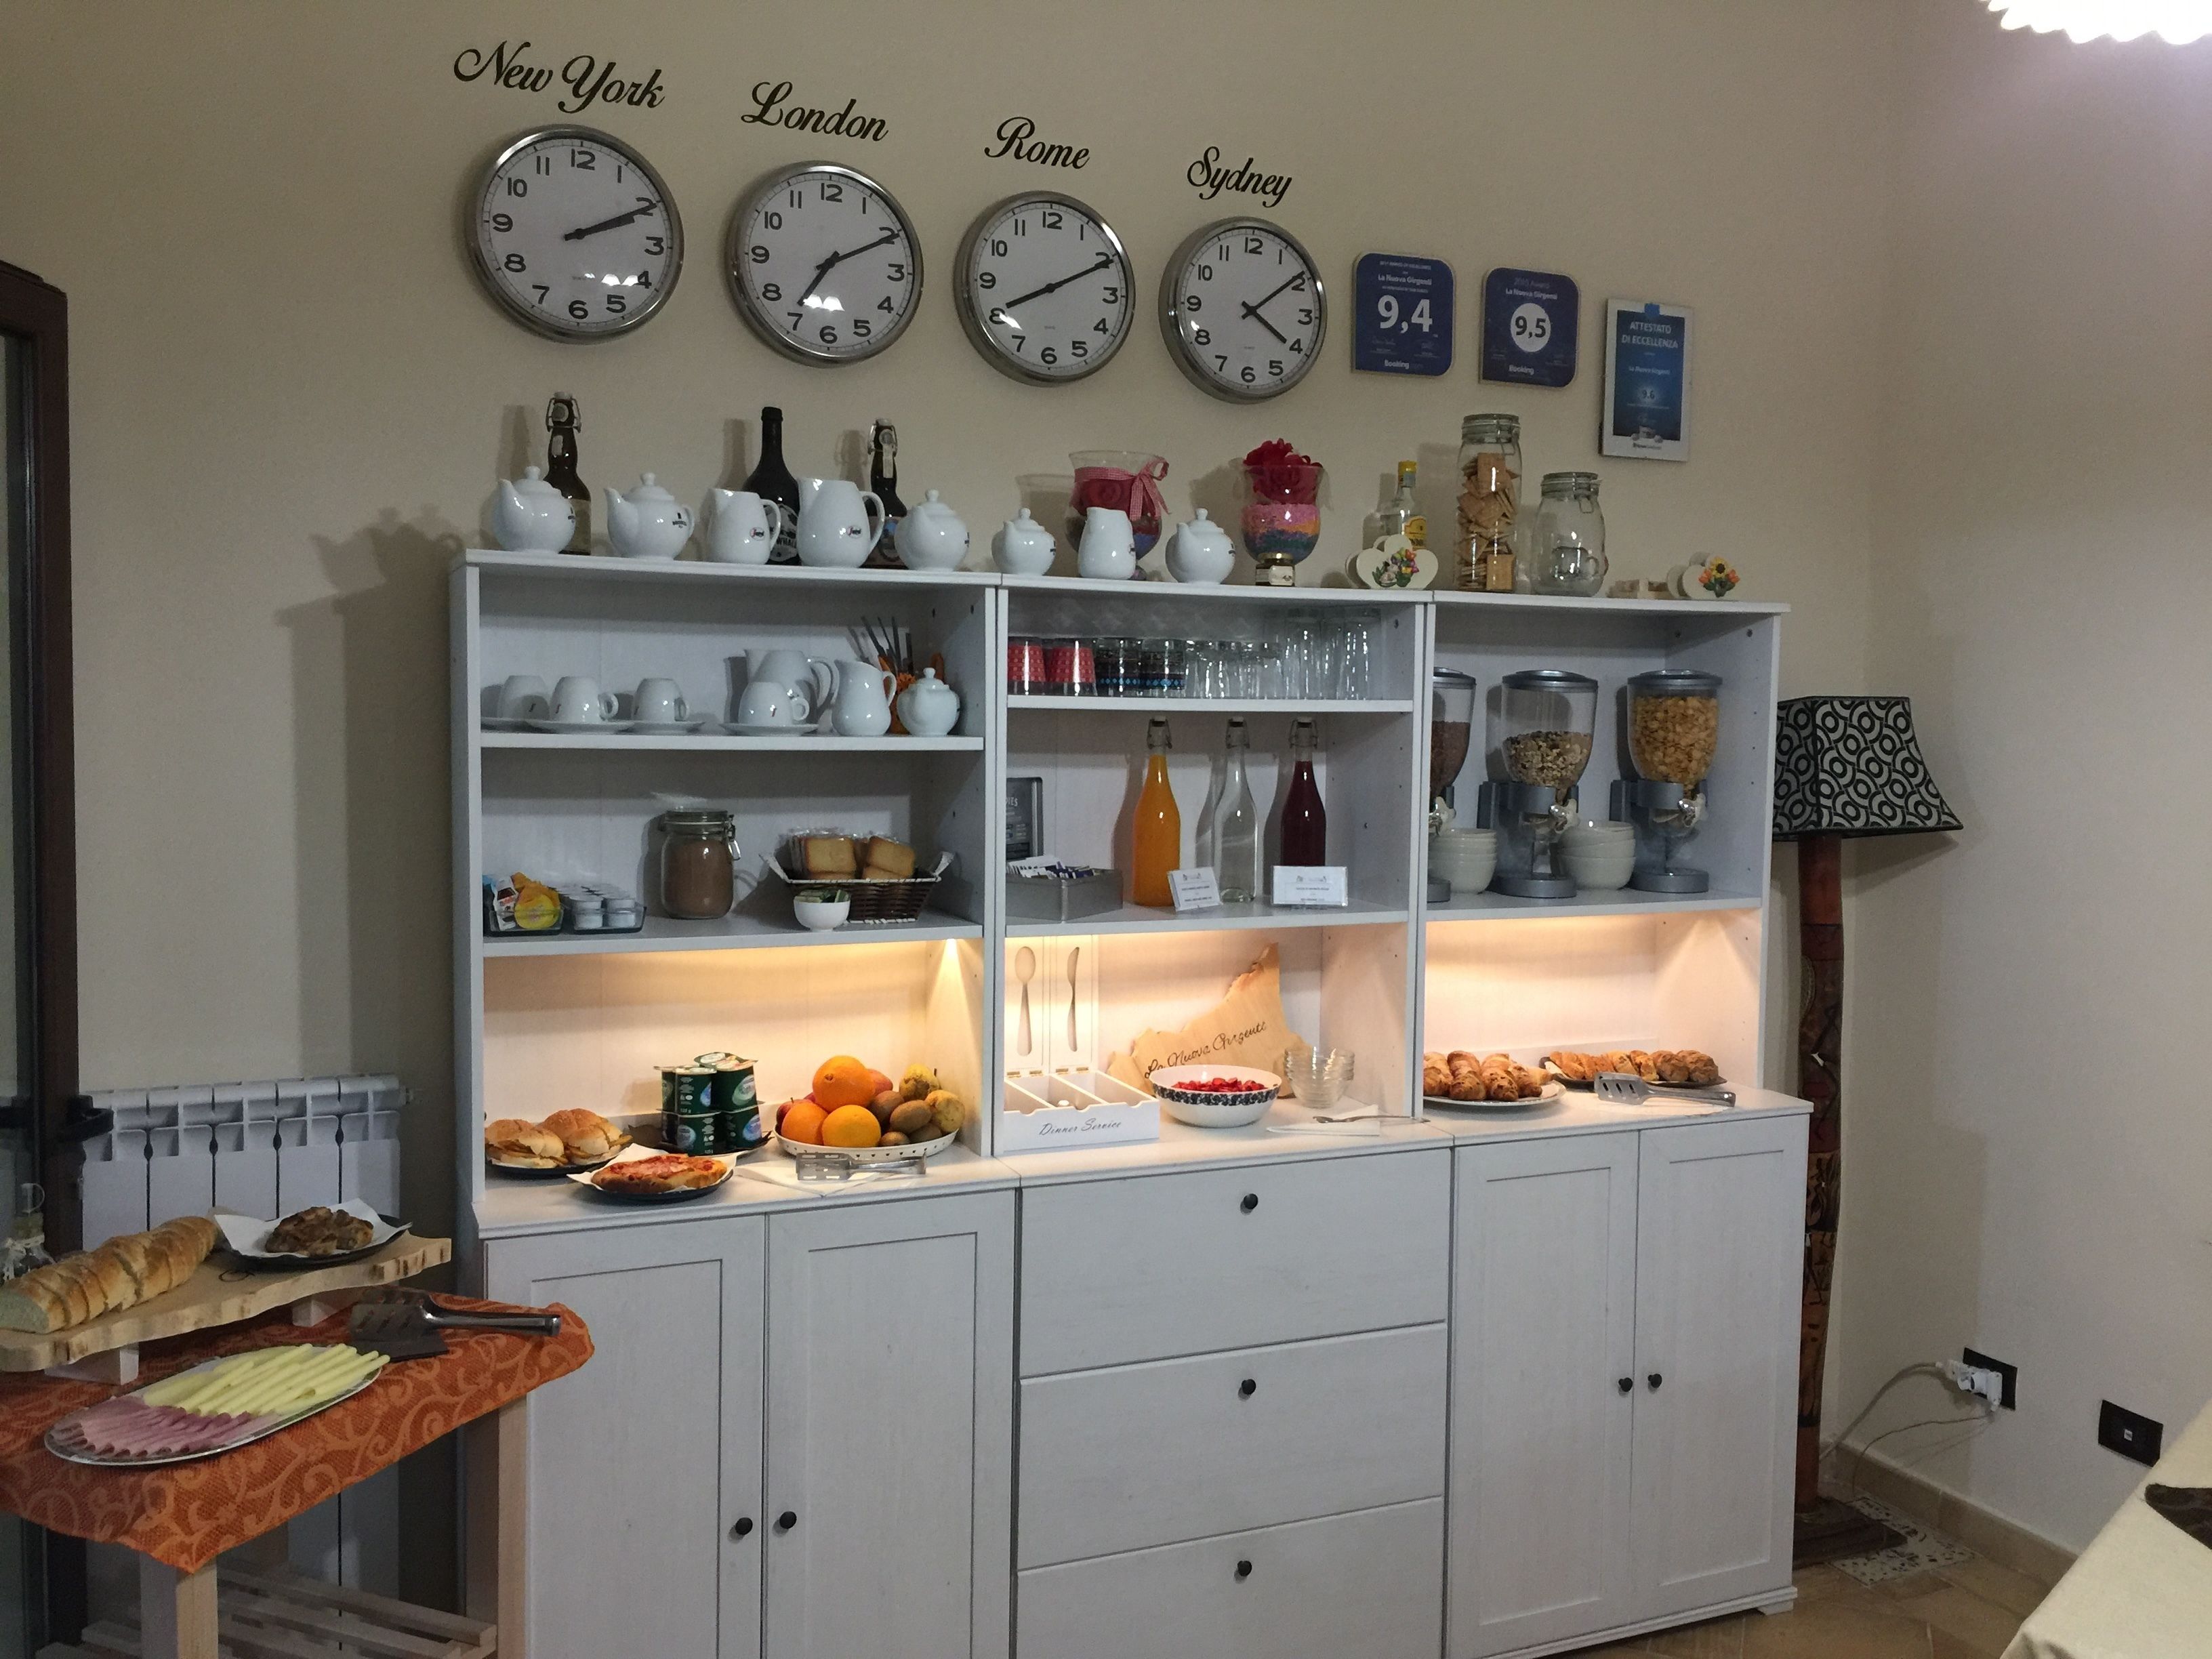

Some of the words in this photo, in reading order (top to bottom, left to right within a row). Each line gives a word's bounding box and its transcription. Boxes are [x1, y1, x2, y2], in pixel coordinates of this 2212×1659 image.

[454, 41, 553, 92] New
[558, 56, 665, 114] York
[741, 81, 888, 142] London
[984, 117, 1090, 169] Rome
[536, 155, 550, 176] 11
[571, 148, 596, 171] 12
[617, 165, 622, 184] 1
[1187, 146, 1292, 208] Sydney
[507, 177, 528, 198] 10
[820, 182, 843, 203] 12
[790, 190, 802, 209] 11
[862, 197, 867, 215] 1
[492, 213, 514, 233] 9
[764, 211, 783, 230] 10
[1014, 218, 1026, 237] 11
[1042, 211, 1063, 230] 12
[1080, 224, 1084, 241] 1
[644, 236, 664, 256] 3
[751, 245, 770, 264] 9
[991, 239, 1008, 258] 10
[1218, 244, 1230, 262] 11
[1244, 237, 1263, 255] 12
[504, 253, 527, 273] 8
[1278, 249, 1283, 265] 1
[635, 270, 653, 289] 4
[886, 263, 905, 282] 3
[979, 272, 997, 290] 9
[1197, 264, 1213, 282] 10
[531, 284, 550, 304] 7
[762, 283, 782, 302] 8
[1102, 286, 1118, 304] 3
[568, 300, 589, 320] 6
[605, 293, 626, 313] 5
[877, 295, 894, 314] 4
[1187, 295, 1202, 312] 9
[787, 312, 804, 331] 7
[988, 307, 1006, 325] 8
[1297, 308, 1313, 326] 3
[1378, 294, 1433, 333] 9,4
[819, 325, 838, 344] 6
[853, 319, 872, 337] 5
[1092, 317, 1109, 335] 4
[1515, 315, 1547, 339] 9,5
[1629, 321, 1672, 334] ATTESTATO
[1011, 334, 1026, 352] 7
[1194, 329, 1211, 346] 8
[1288, 338, 1303, 354] 4
[1621, 334, 1631, 344] DI
[1632, 335, 1679, 348] ECCELLENZA
[1040, 346, 1058, 365] 6
[1071, 340, 1088, 358] 5
[1214, 354, 1228, 372] 7
[1268, 359, 1284, 376] 5
[1240, 366, 1256, 383] 6
[1641, 390, 1656, 399] 9.6
[1167, 1045, 1211, 1067] Nuova
[1038, 1122, 1079, 1136] Dinner
[1080, 1117, 1122, 1132] Service
